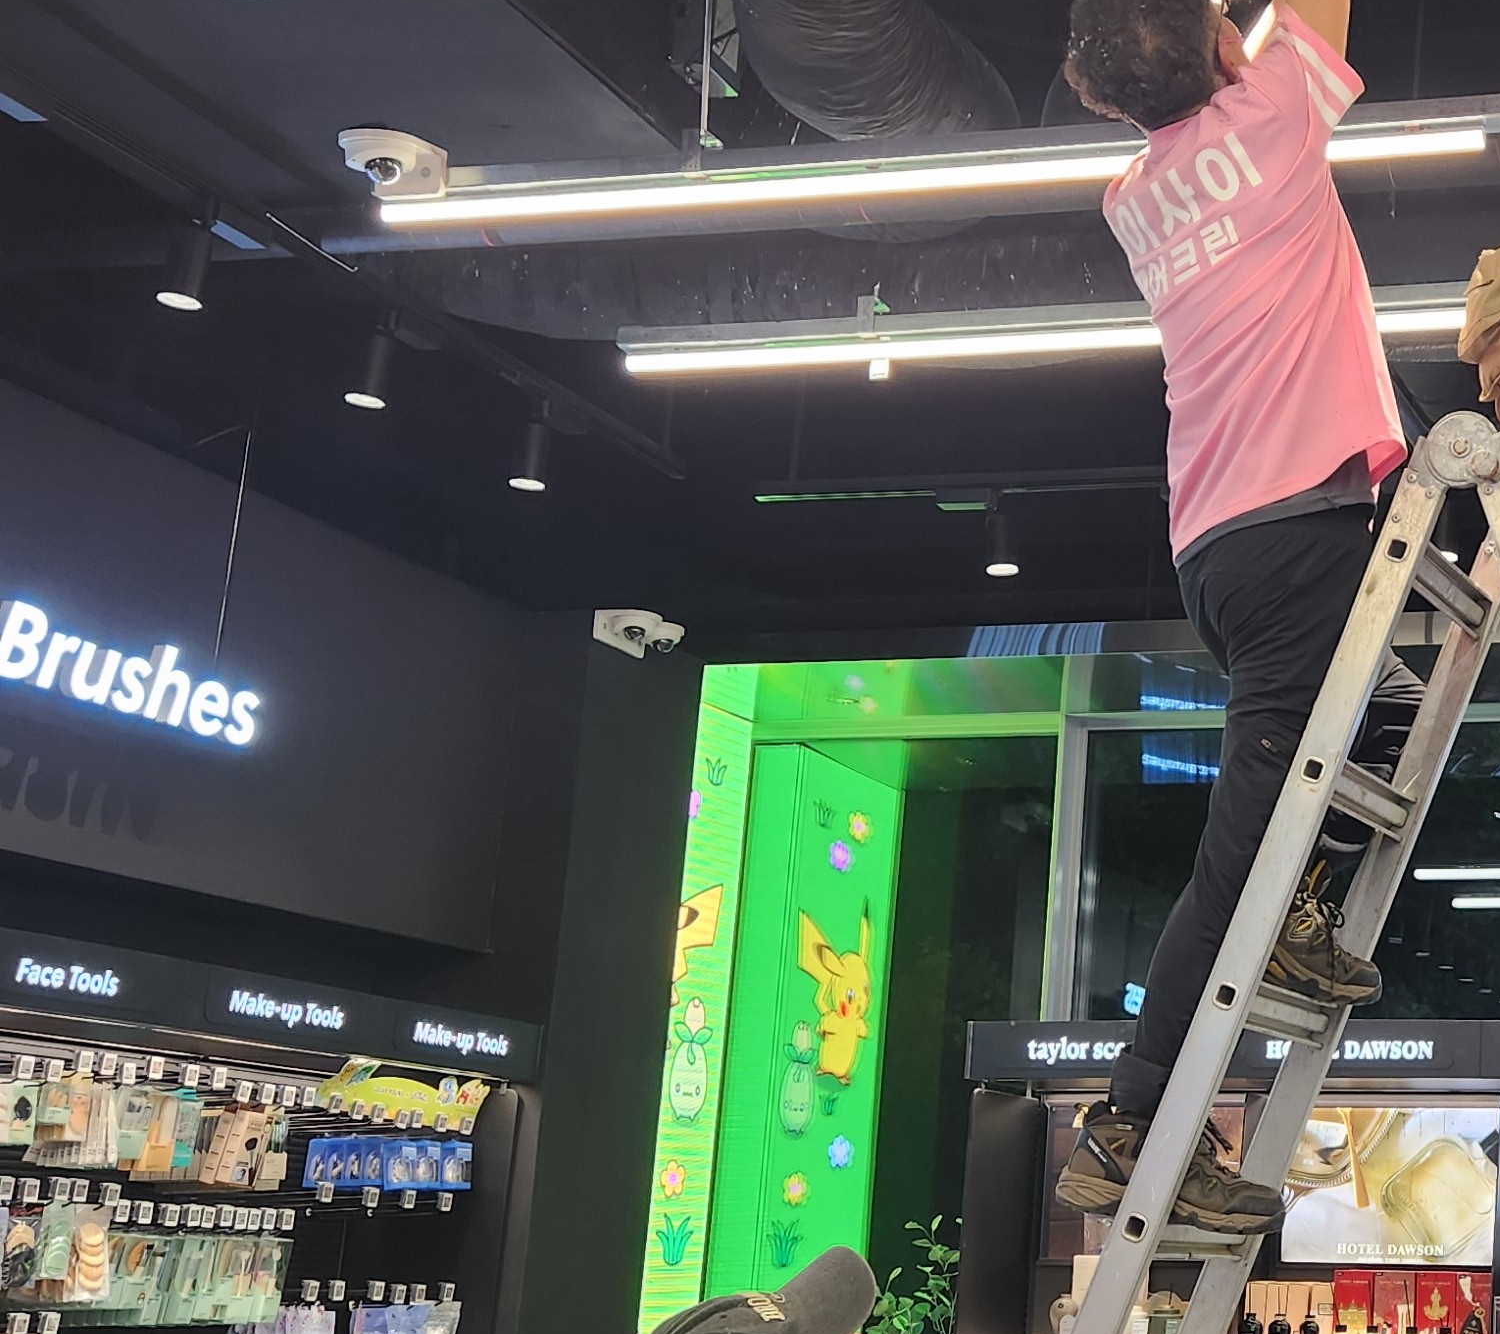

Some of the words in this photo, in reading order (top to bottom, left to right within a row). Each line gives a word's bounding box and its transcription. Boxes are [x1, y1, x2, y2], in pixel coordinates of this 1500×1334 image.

[1113, 131, 1263, 256] 이사이
[0, 600, 260, 746] Brushes
[15, 957, 64, 987] Face
[69, 964, 120, 997] Tools
[229, 990, 303, 1029] Make-up
[306, 1001, 345, 1030] Tools
[413, 1020, 474, 1055] Make-up
[477, 1035, 508, 1057] Tools
[1027, 1036, 1090, 1065] taylor
[1344, 1040, 1434, 1060] DAWSON
[1337, 1243, 1383, 1255] HOTEL
[1388, 1244, 1445, 1257] DAWSON
